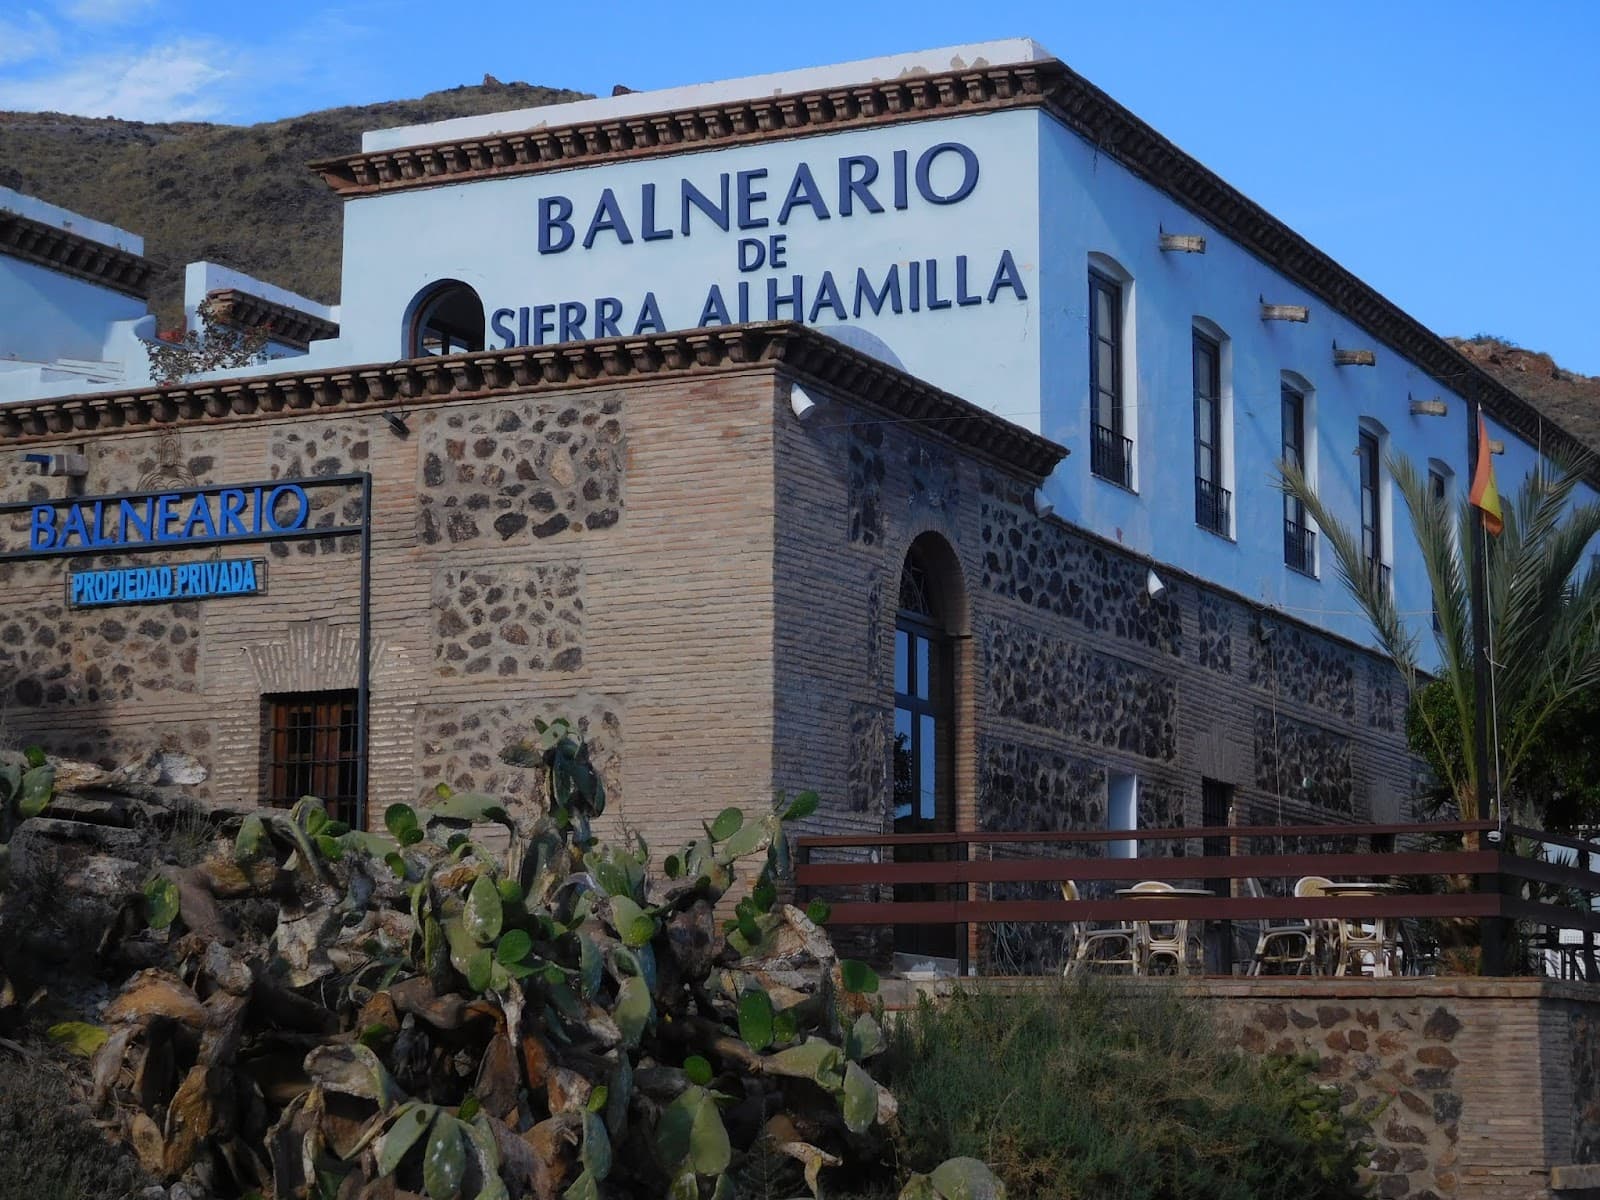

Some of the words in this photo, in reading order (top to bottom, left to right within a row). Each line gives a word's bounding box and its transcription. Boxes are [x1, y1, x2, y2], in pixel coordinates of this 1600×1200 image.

[538, 142, 979, 254] BALNEARIO
[737, 234, 787, 272] DE
[30, 484, 309, 550] BALNEARIO
[72, 567, 172, 603] PROPIEDAD
[177, 560, 256, 596] PRIVADA
